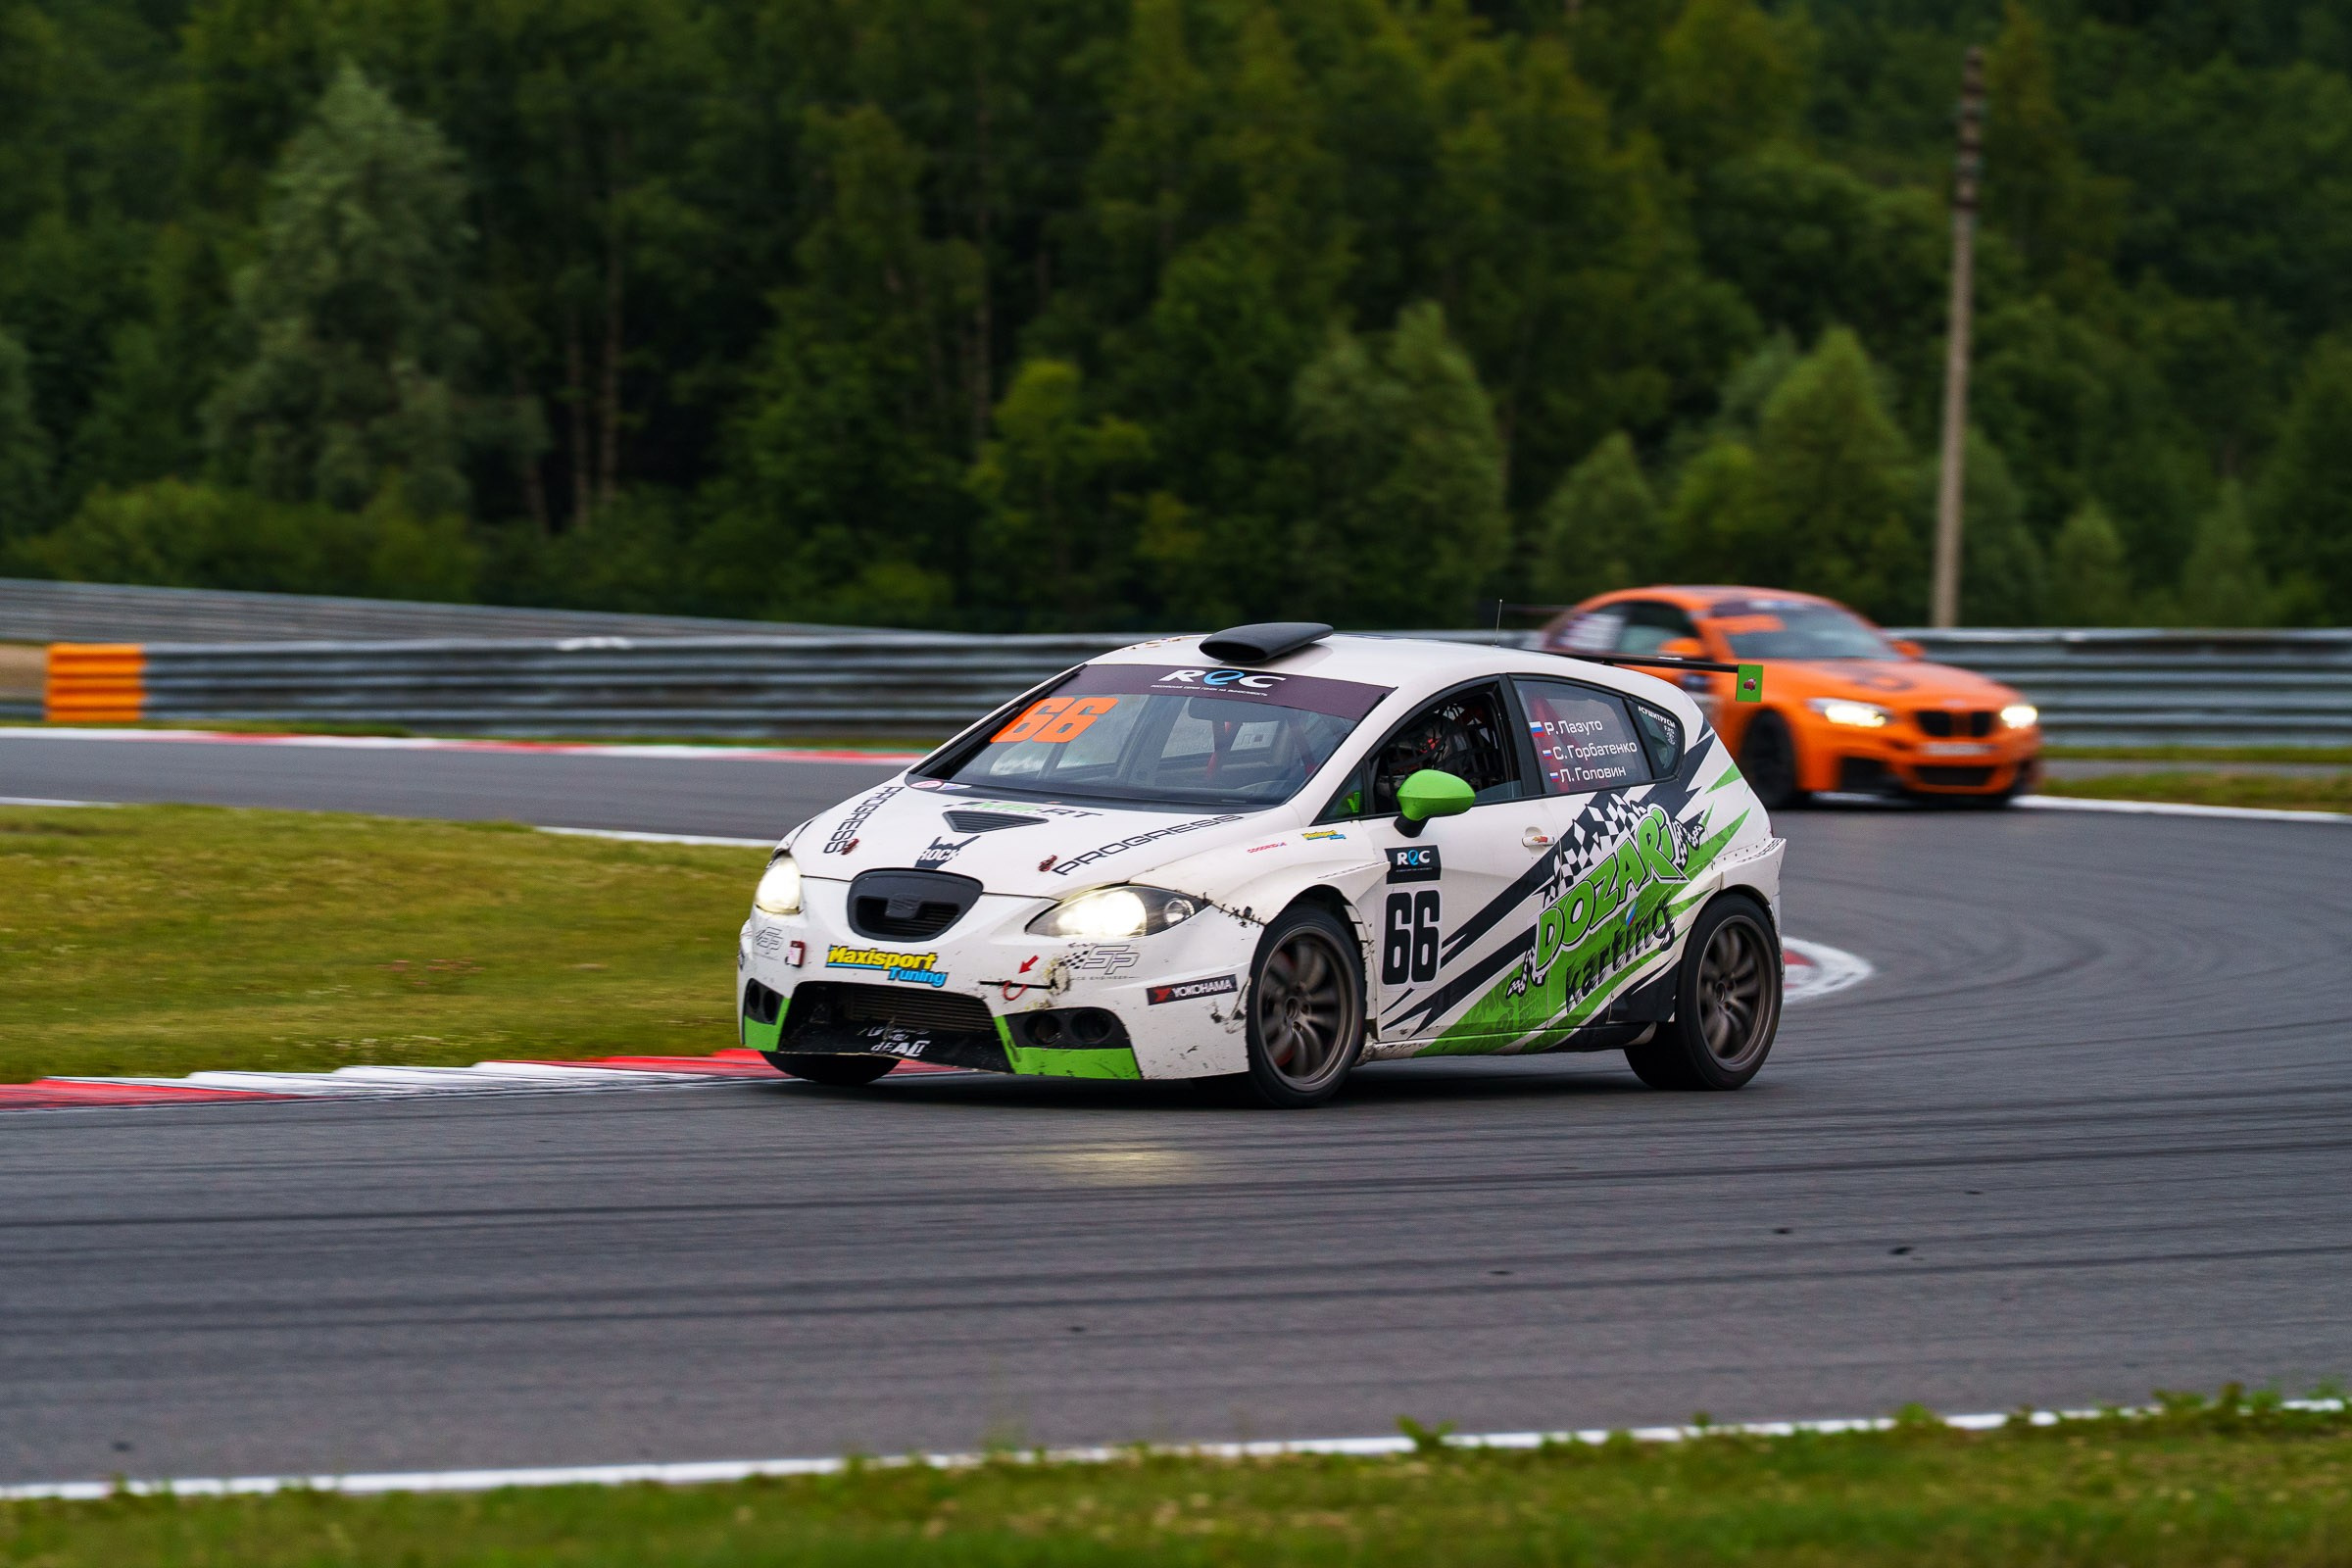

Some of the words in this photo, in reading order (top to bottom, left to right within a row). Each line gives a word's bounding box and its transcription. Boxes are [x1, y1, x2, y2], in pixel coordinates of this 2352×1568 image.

[990, 697, 1119, 743] 66
[1544, 720, 1603, 736] Р.Лазуто
[1552, 742, 1638, 760] С.Горбатенко
[1560, 766, 1627, 783] Л.Головин
[823, 786, 905, 855] PROGRESS
[917, 848, 960, 861] ROCK
[1052, 814, 1244, 875] PROGRESS
[1382, 890, 1441, 985] 66
[827, 946, 939, 970] Maxisport
[888, 966, 950, 988] Tuning
[1172, 979, 1233, 998] YOKOHAMA
